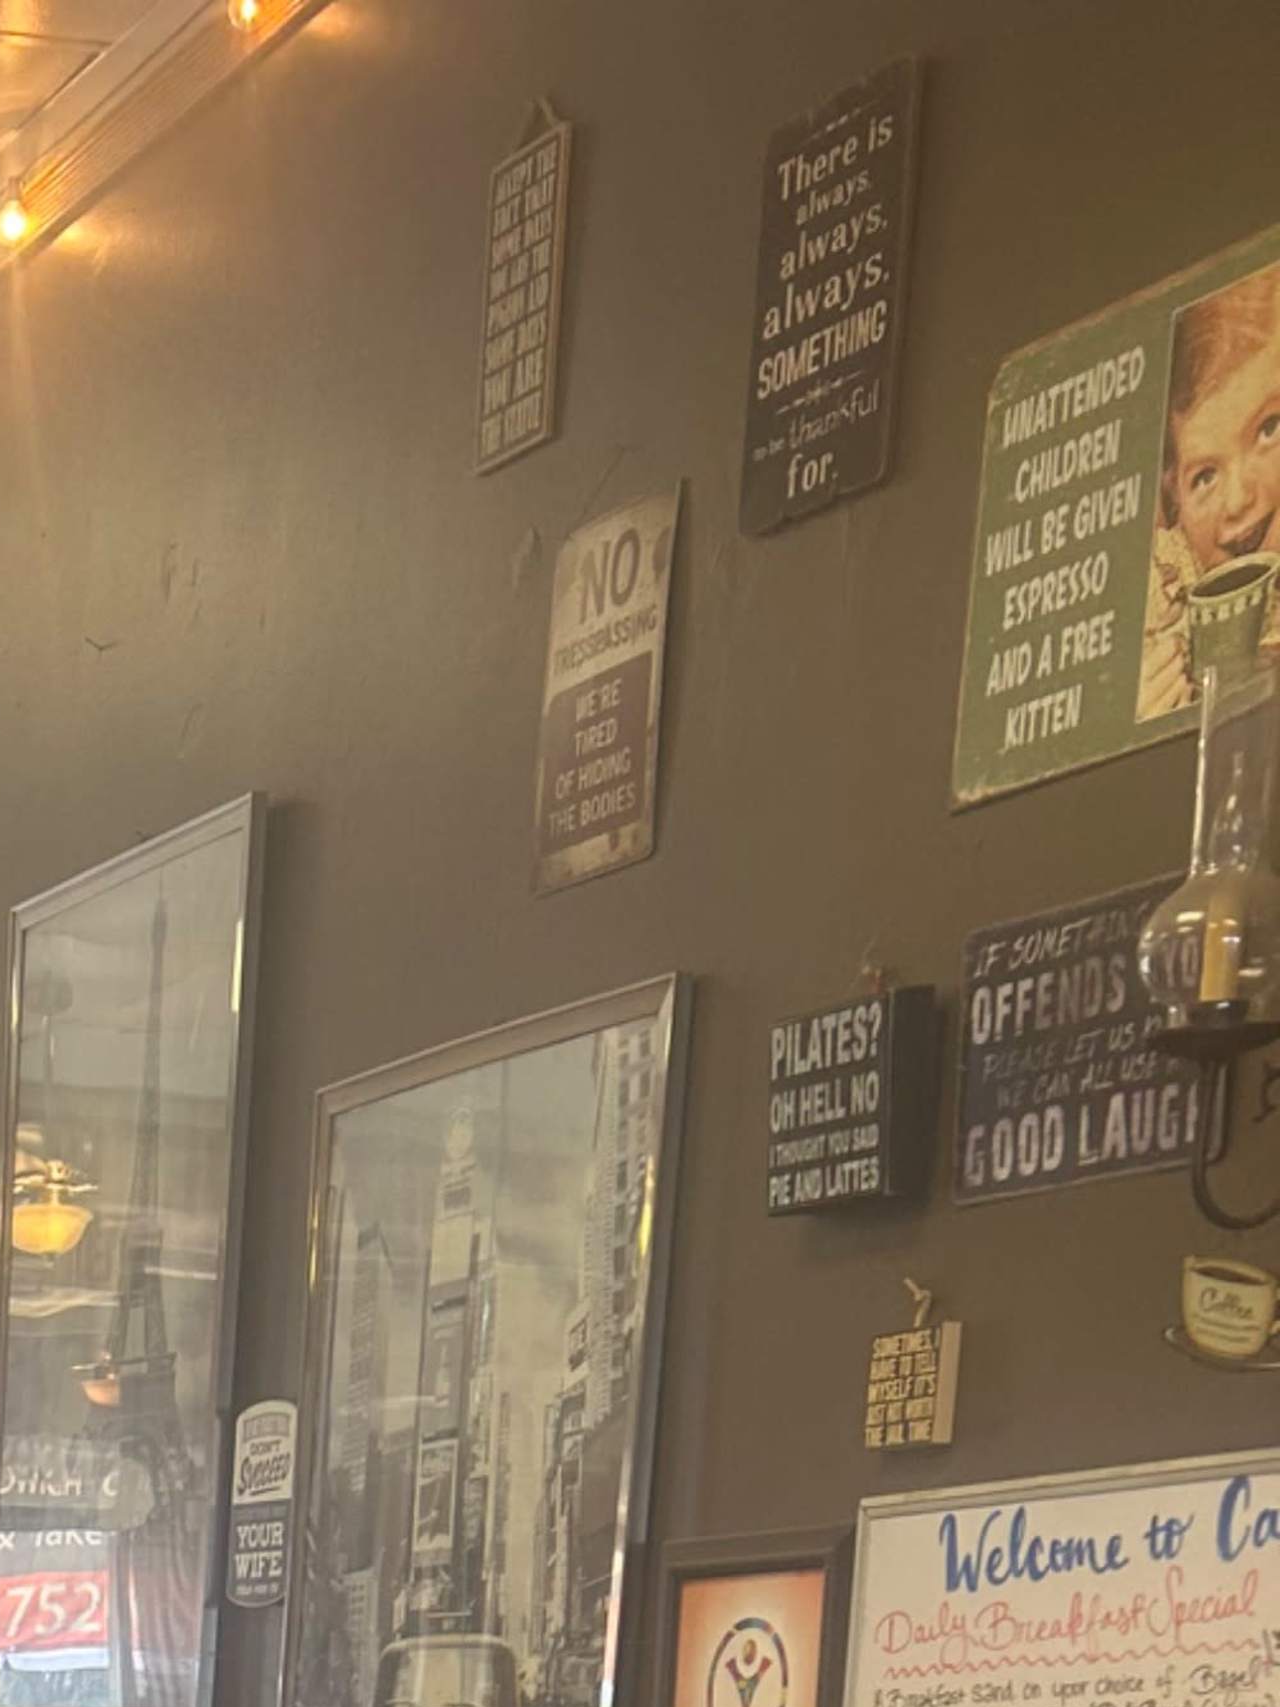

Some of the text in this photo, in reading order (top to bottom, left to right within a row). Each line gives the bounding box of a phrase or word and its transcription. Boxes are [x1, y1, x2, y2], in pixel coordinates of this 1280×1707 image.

[778, 115, 893, 201] There is
[757, 300, 887, 399] SOMETHING
[790, 379, 880, 448] thankful
[1004, 345, 1145, 449] UNATTENDED
[1015, 419, 1122, 503] CHILDREN
[986, 473, 1141, 576] WILL BE GIVEN
[580, 527, 640, 625] NO
[1003, 552, 1108, 632] ESPRESSO
[986, 610, 1115, 696] AND A FREE
[576, 678, 622, 723] WE'RE
[1003, 684, 1082, 751] KITTEN
[575, 718, 617, 757] TIRED
[555, 747, 632, 799] OF HIDING
[549, 783, 636, 838] THE BODIES
[973, 941, 1007, 979] IF
[972, 953, 1126, 1045] OFFENDS
[771, 1001, 883, 1081] PILATES?
[1109, 1022, 1135, 1050] US
[771, 1070, 880, 1134] OH HELL NO
[1080, 1063, 1114, 1092] ALL
[1121, 1052, 1157, 1081] USE
[769, 1123, 879, 1169] I THOUGHT YOU SAID
[964, 1103, 1065, 1187] GOOD
[769, 1156, 879, 1209] PIE AND LATTES
[235, 1550, 283, 1579] WIFE
[236, 1522, 283, 1549] YOUR
[940, 1504, 1195, 1594] Welcome to
[5, 1581, 102, 1638] 752
[875, 1601, 975, 1670] Daily
[975, 1590, 1146, 1660] Breakfast
[1147, 1566, 1259, 1653] Special
[1023, 1681, 1041, 1700] on
[1051, 1679, 1089, 1706] your
[1095, 1675, 1144, 1696] choice
[1155, 1664, 1174, 1699] of
[1189, 1655, 1263, 1707] Bagel
